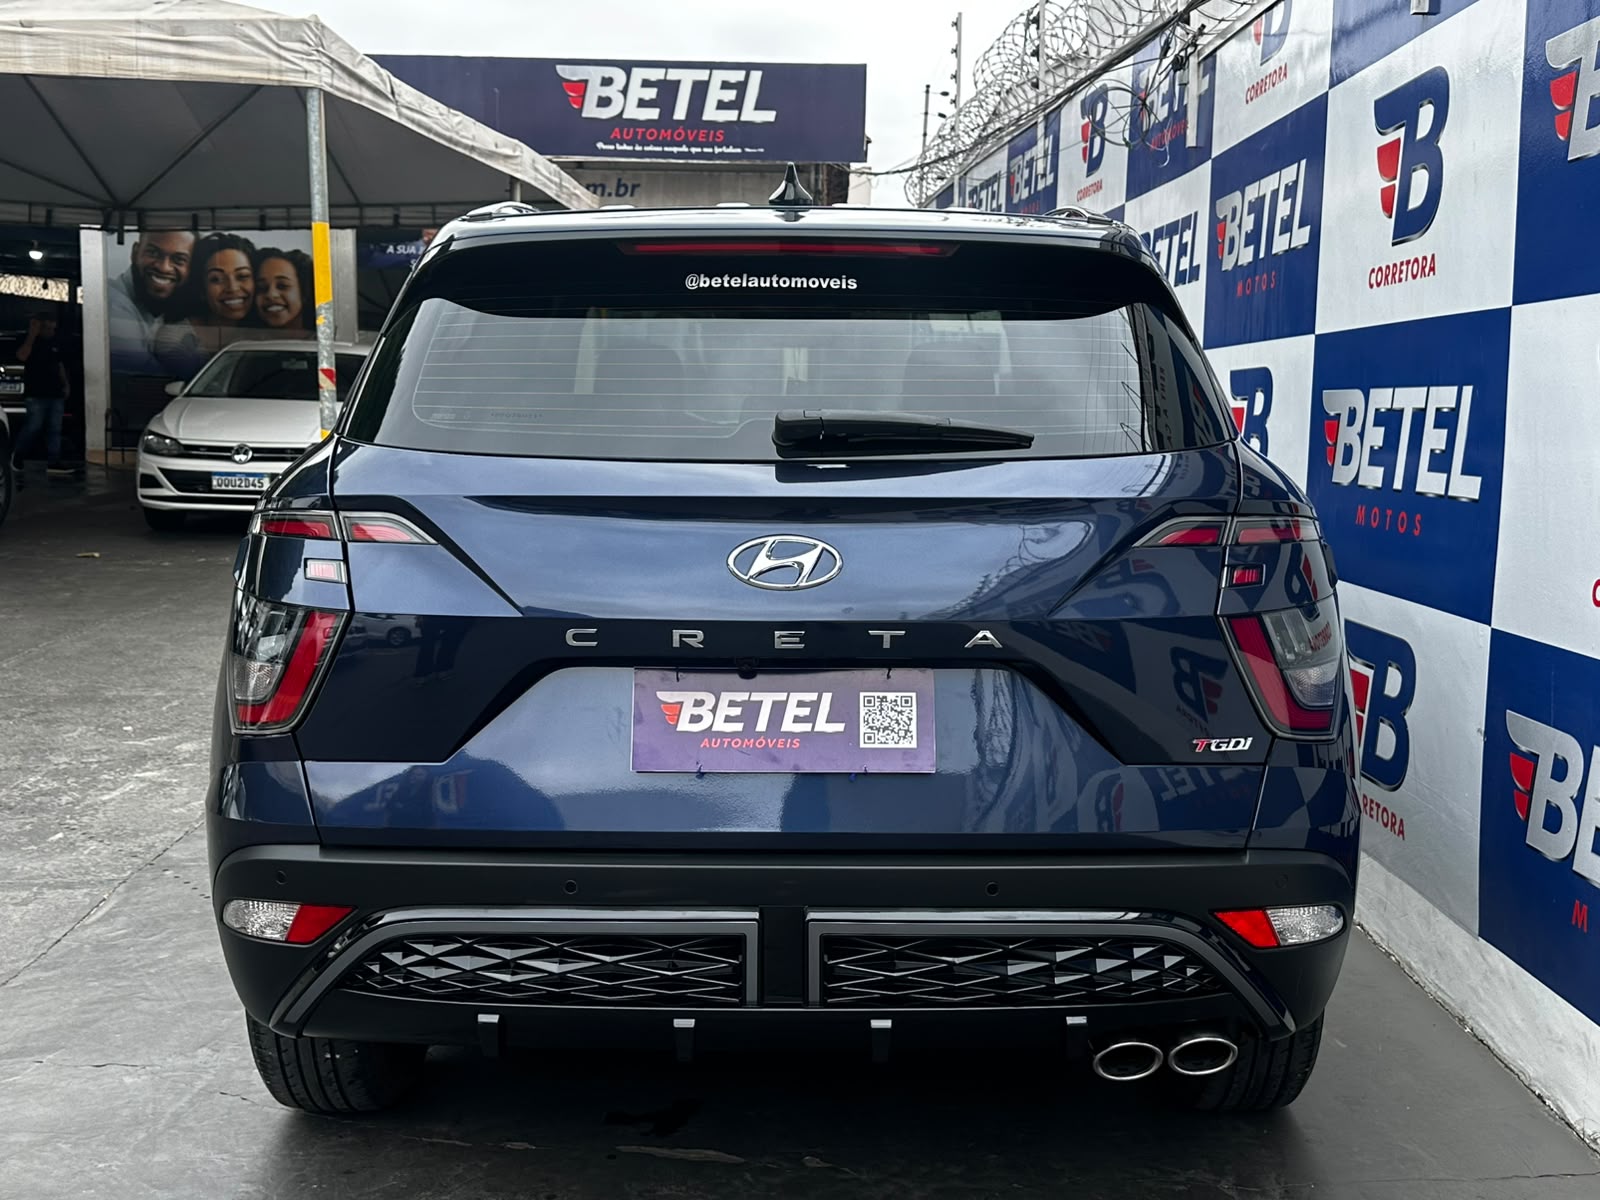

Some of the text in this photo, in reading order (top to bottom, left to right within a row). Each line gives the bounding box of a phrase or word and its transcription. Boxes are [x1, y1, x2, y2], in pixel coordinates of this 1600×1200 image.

[556, 65, 777, 122] BETEL
[610, 125, 725, 142] AUTOMÓVEIS
[584, 177, 641, 197] m.br
[1216, 158, 1312, 272] BETEL
[1141, 210, 1201, 287] ETEL
[685, 273, 858, 290] @betelautomoveis
[1236, 272, 1277, 297] MOTOS
[1368, 253, 1437, 290] CORRETORA
[1322, 385, 1483, 502] BETEL
[1355, 504, 1423, 537] MOTOS
[565, 628, 1003, 648] CRETA
[656, 691, 845, 734] BETEL
[701, 736, 800, 749] AUTOMÓVEIS
[1362, 793, 1406, 841] RETORA
